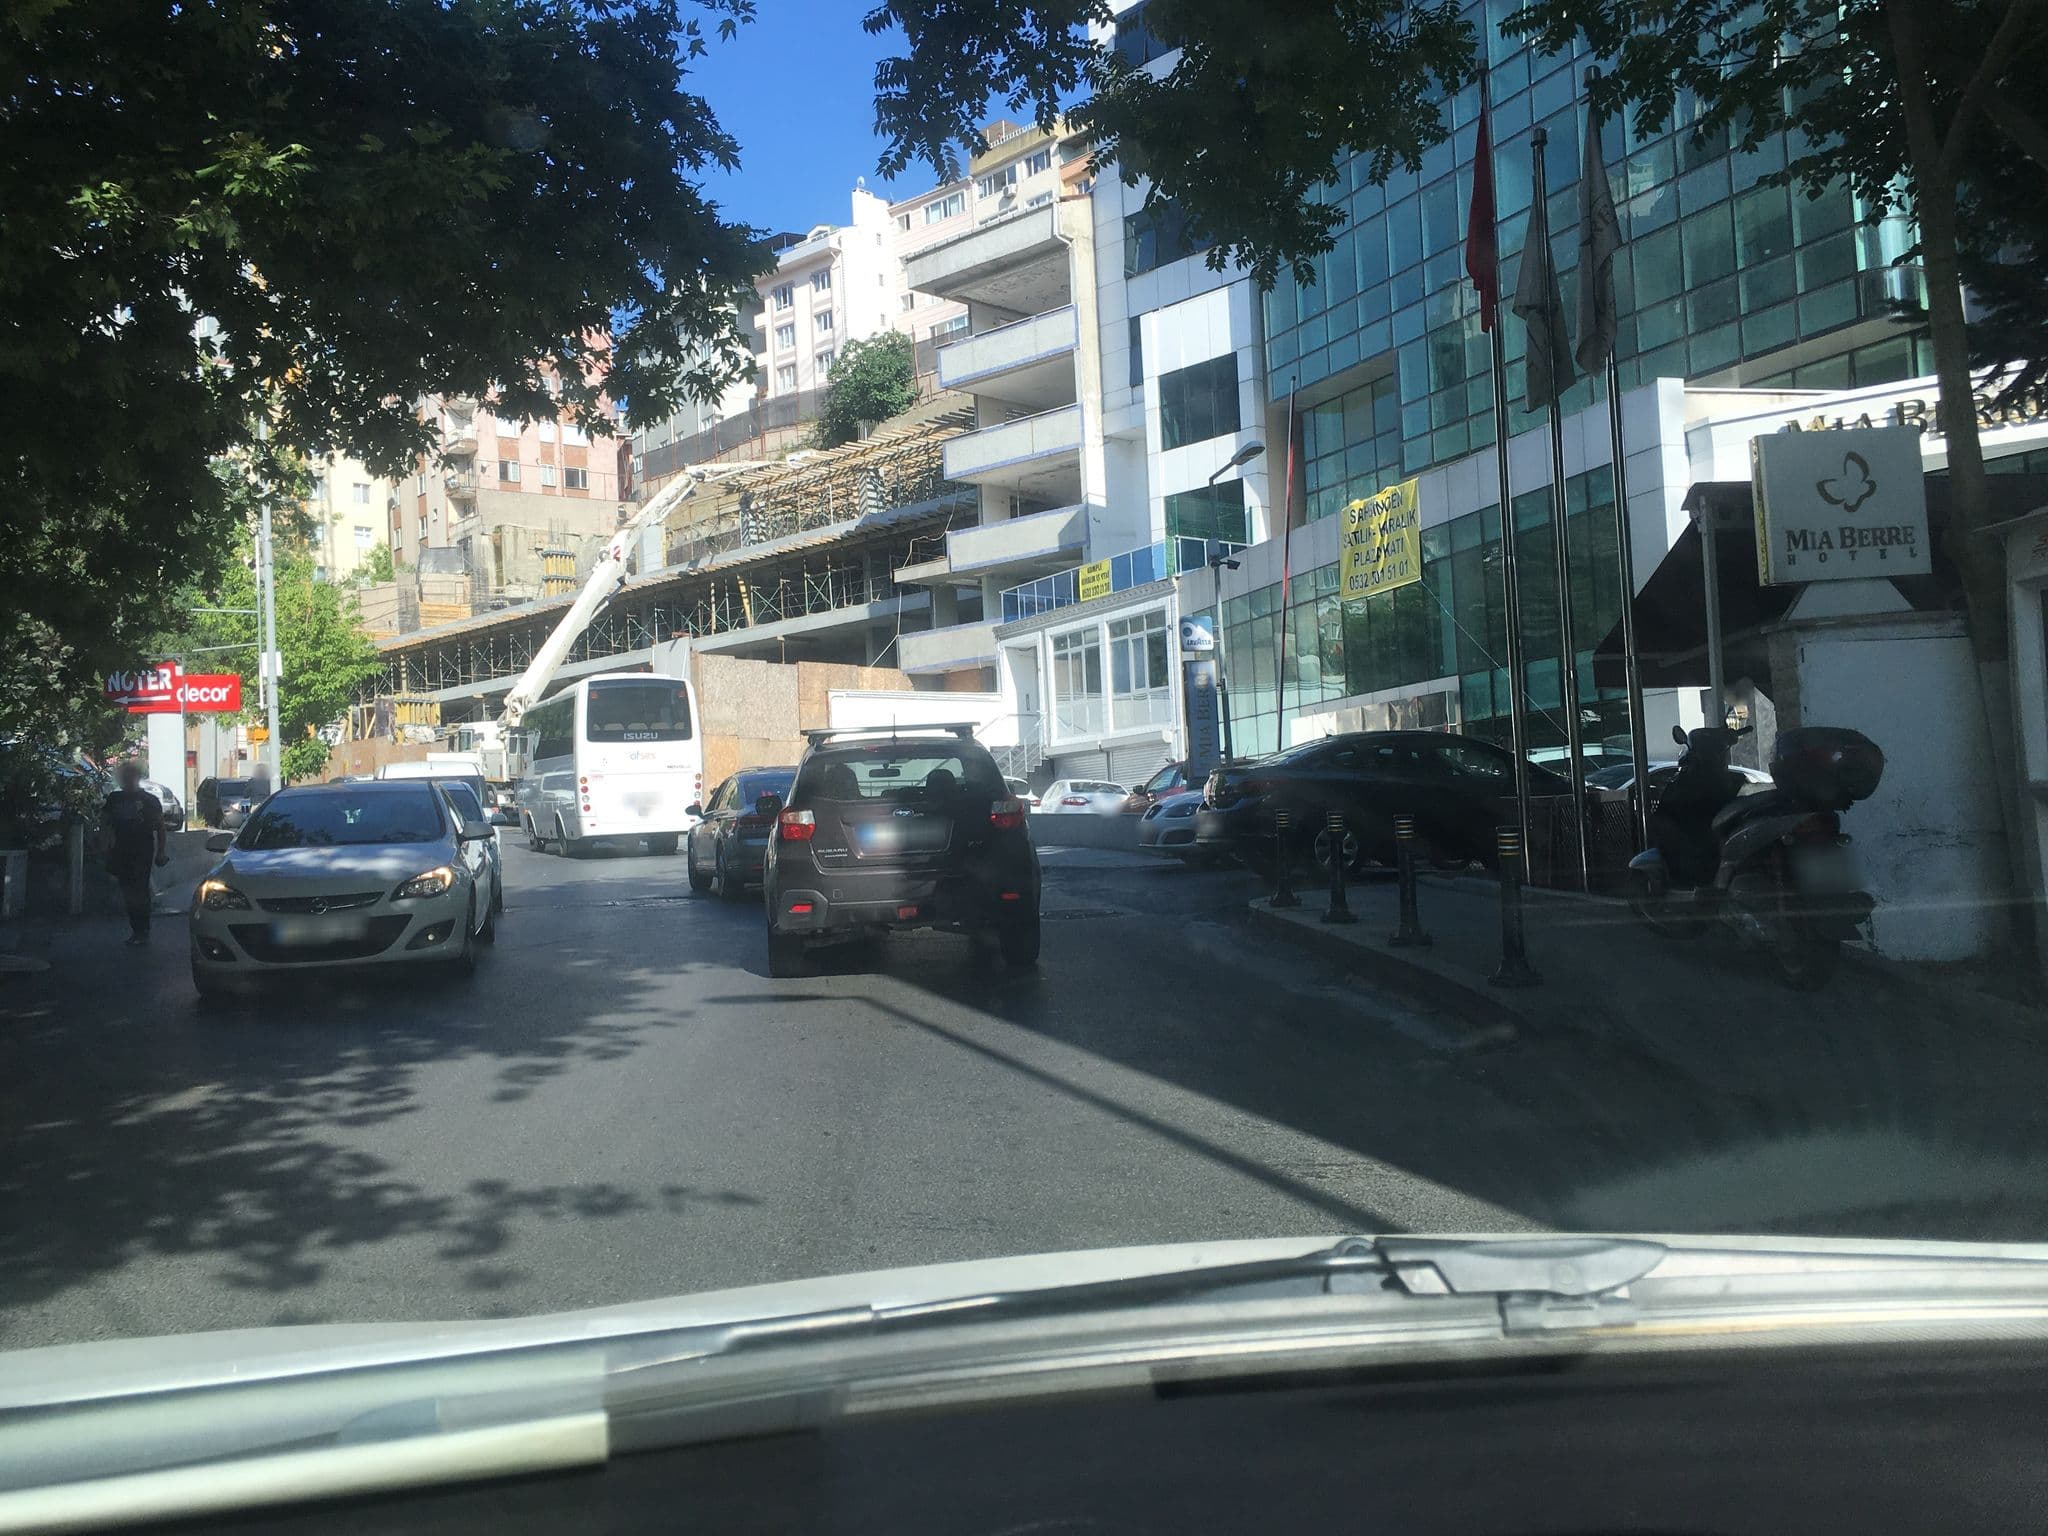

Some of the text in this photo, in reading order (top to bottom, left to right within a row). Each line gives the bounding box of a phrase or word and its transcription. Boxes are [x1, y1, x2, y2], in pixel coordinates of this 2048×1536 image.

[1785, 526, 1916, 552] MIA BERRE
[1787, 546, 1917, 565] HOTEL
[1349, 573, 1369, 591] 0532
[1388, 564, 1396, 580] 51
[1400, 559, 1409, 576] 01
[624, 732, 658, 740] ISUZU
